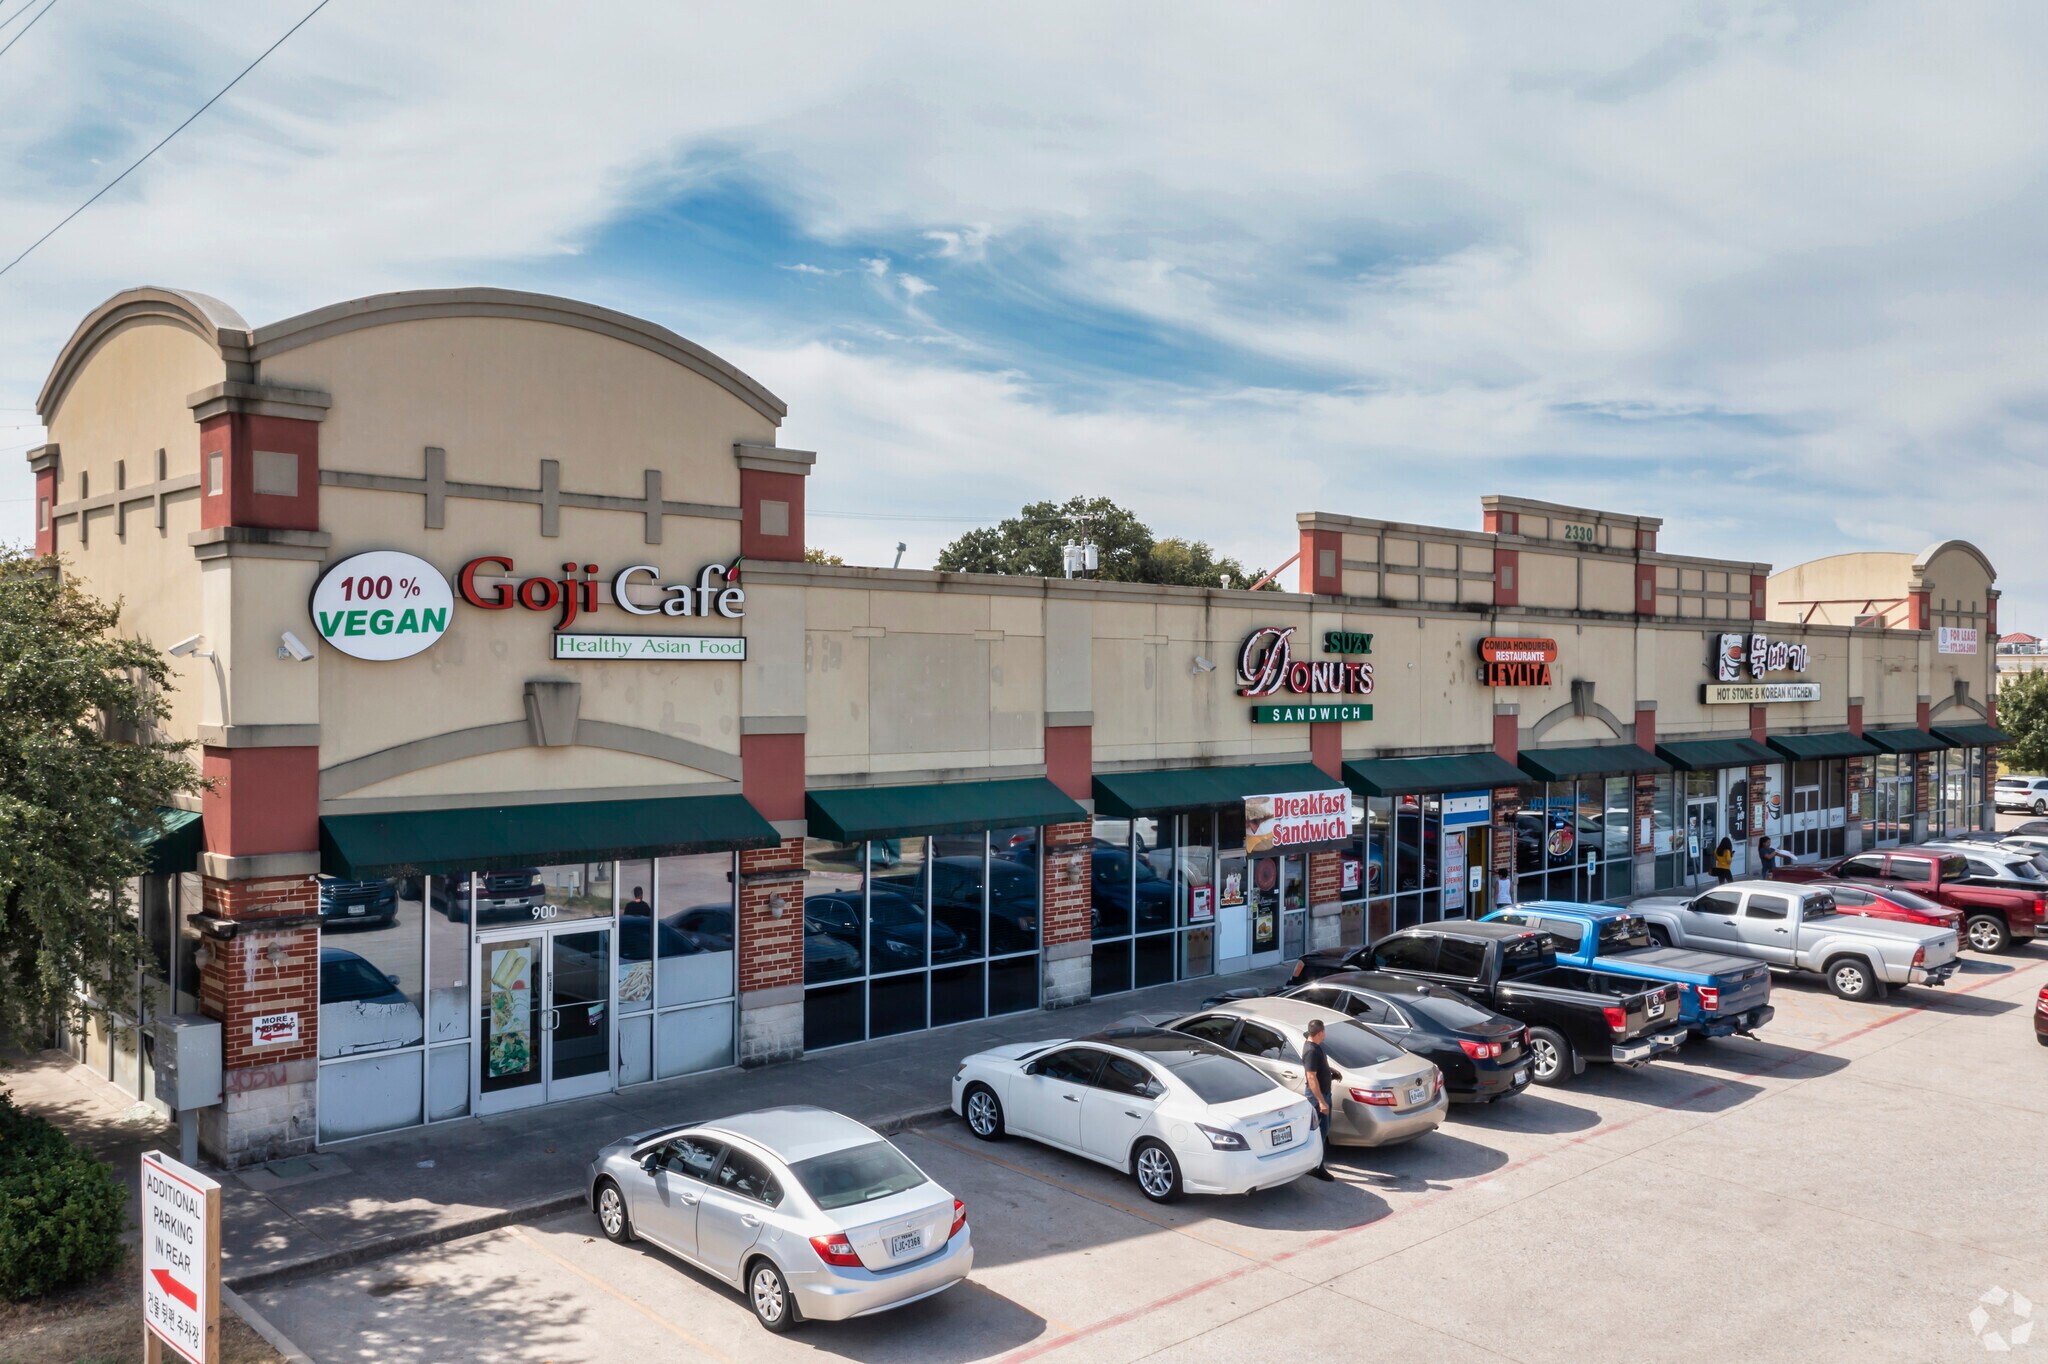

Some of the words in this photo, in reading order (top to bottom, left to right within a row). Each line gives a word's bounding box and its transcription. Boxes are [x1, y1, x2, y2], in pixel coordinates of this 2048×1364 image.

[1565, 525, 1592, 542] 2330
[341, 576, 392, 601] 100
[400, 577, 420, 599] %
[458, 556, 598, 630] Goji
[319, 608, 446, 637] VEGAN
[559, 637, 632, 657] Healthy
[641, 639, 690, 654] Asian
[699, 639, 742, 654] Food
[1328, 631, 1373, 654] SUZY
[1484, 641, 1512, 650] COMIDA
[1950, 629, 1960, 641] FOR
[1961, 630, 1976, 642] LEASE
[1238, 626, 1374, 697] DONUTS
[1495, 651, 1545, 661] RESTAURANTE
[1751, 635, 1806, 678] 뚝배기
[1488, 663, 1552, 686] LEYLITA
[1717, 688, 1731, 700] HOT
[1732, 687, 1753, 700] STONE
[1755, 688, 1760, 699] &
[1761, 686, 1786, 699] KOREAN
[1788, 686, 1813, 698] KITCHEN
[1272, 707, 1360, 721] SANDWICH
[1274, 792, 1346, 818] Breakfast
[1273, 817, 1346, 845] Sandwich
[532, 905, 557, 920] 900
[262, 1015, 288, 1024] MORE
[147, 1174, 200, 1220] ADDITIONAL
[153, 1205, 193, 1245] PARKING
[155, 1235, 164, 1254] IN
[166, 1243, 191, 1274] REAR
[147, 1291, 160, 1320] 건물
[162, 1302, 175, 1332] 뒷편
[177, 1314, 199, 1349] 주차장
